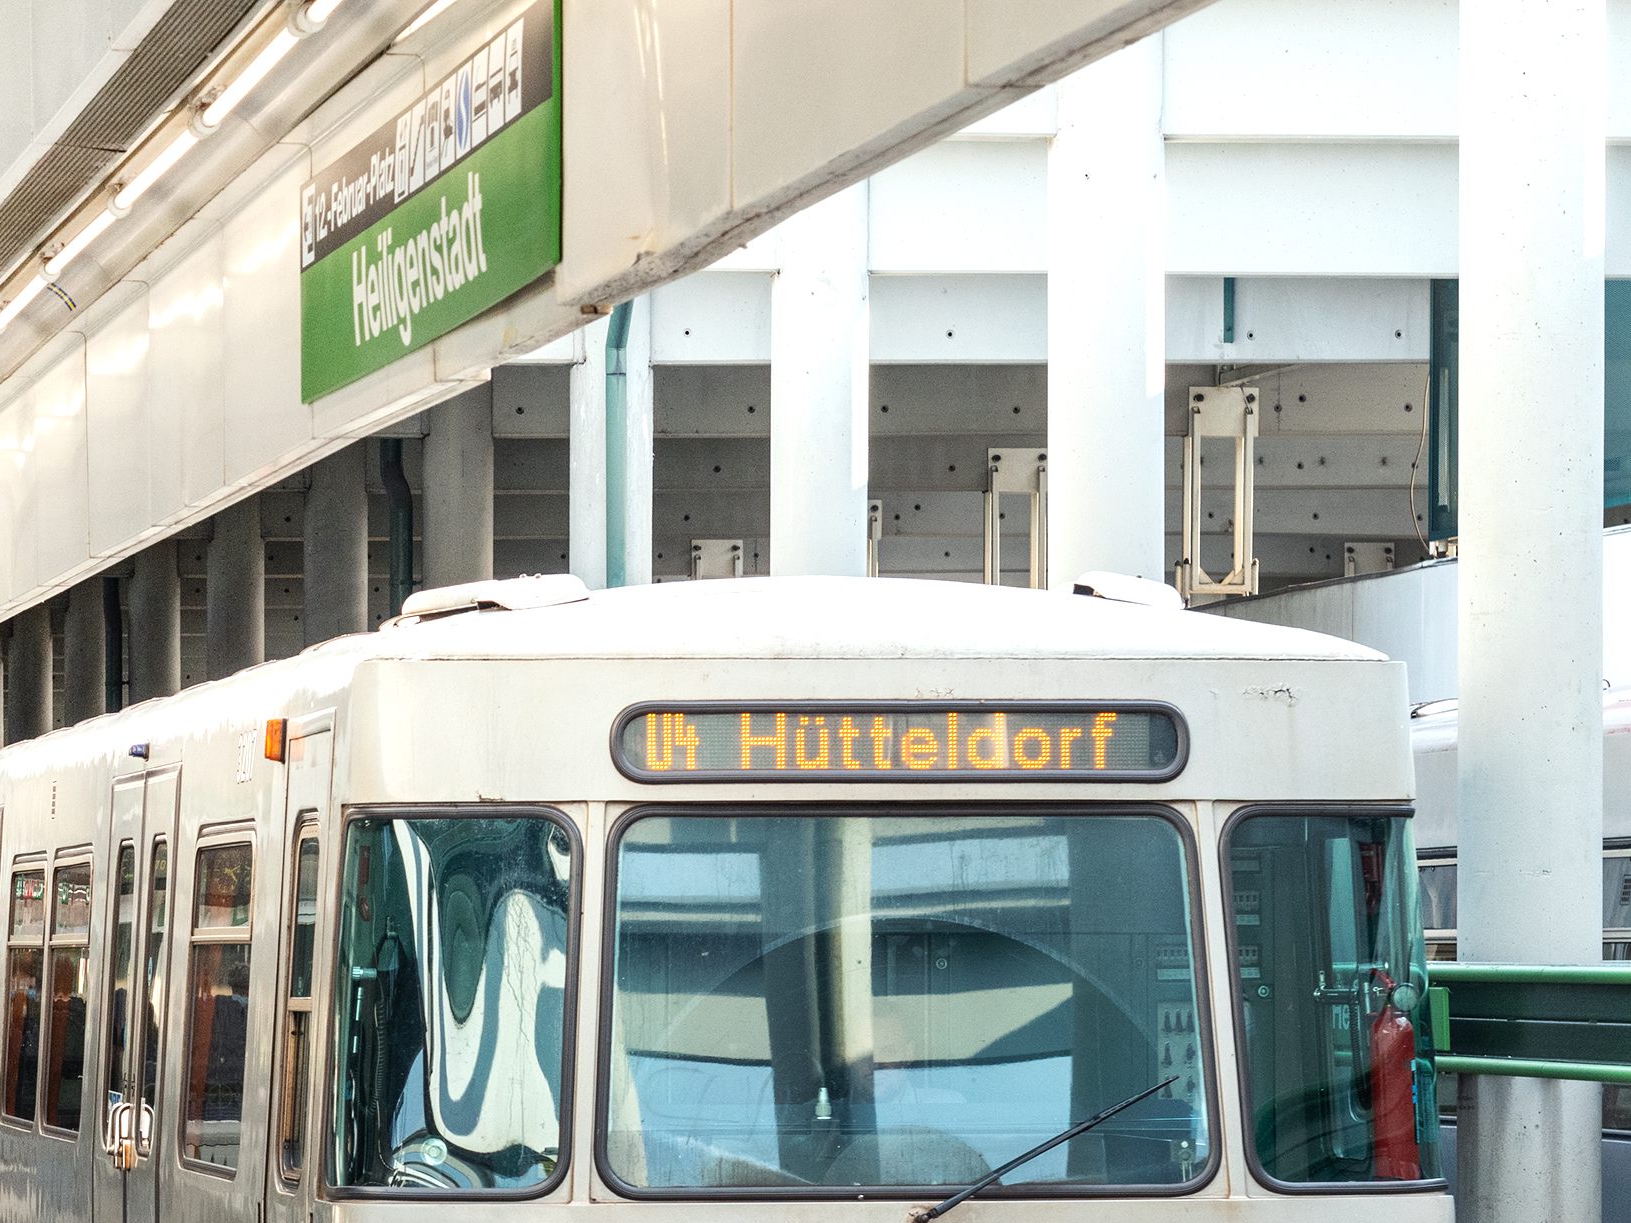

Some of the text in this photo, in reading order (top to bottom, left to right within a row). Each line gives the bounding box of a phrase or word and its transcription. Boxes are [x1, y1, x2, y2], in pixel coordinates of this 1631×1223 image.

[314, 147, 395, 241] 12.-Februar-Platz
[351, 172, 488, 346] Heiligenstadt
[645, 712, 1117, 770] U4 Hütteldorf
